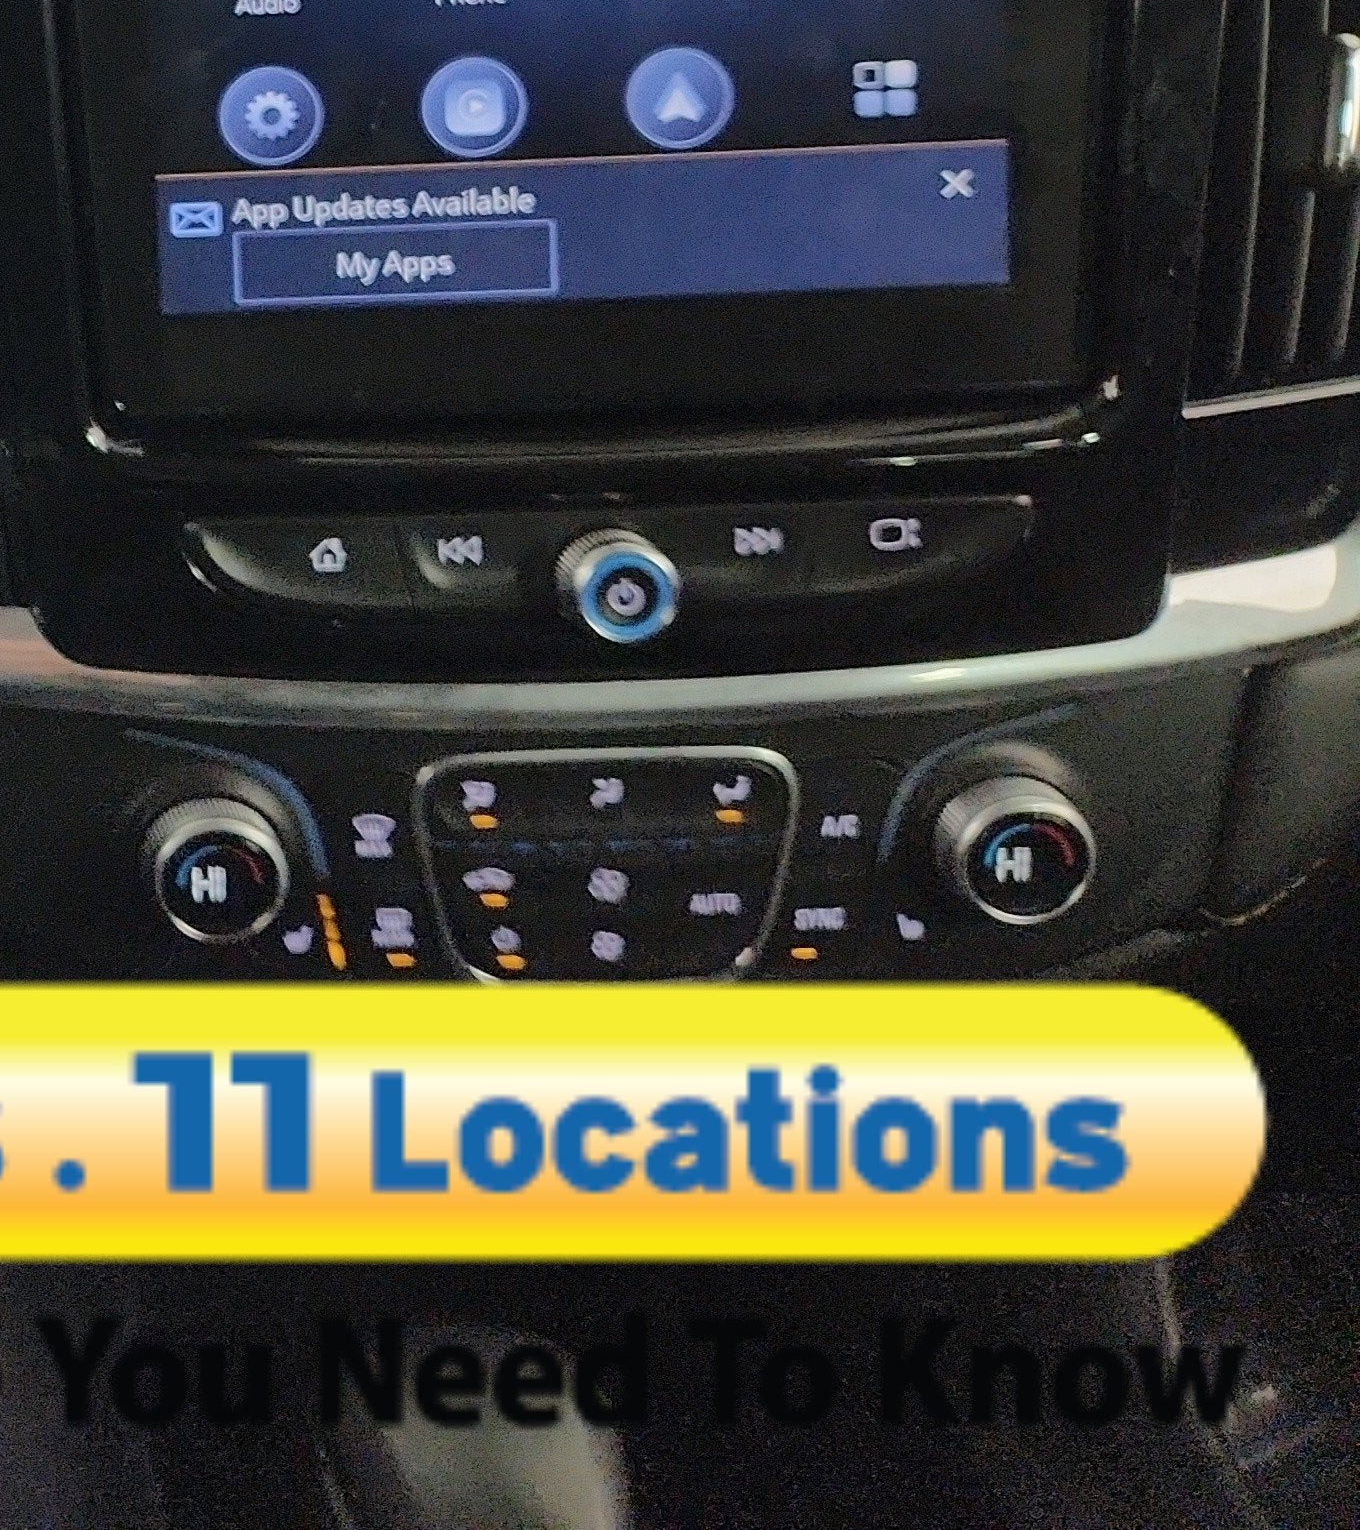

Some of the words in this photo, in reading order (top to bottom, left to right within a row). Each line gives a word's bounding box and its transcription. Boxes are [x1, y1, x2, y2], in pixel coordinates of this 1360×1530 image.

[231, 198, 289, 230] App
[291, 192, 409, 228] Updates
[411, 185, 537, 219] Available
[335, 251, 380, 286] My
[381, 249, 456, 283] Apps
